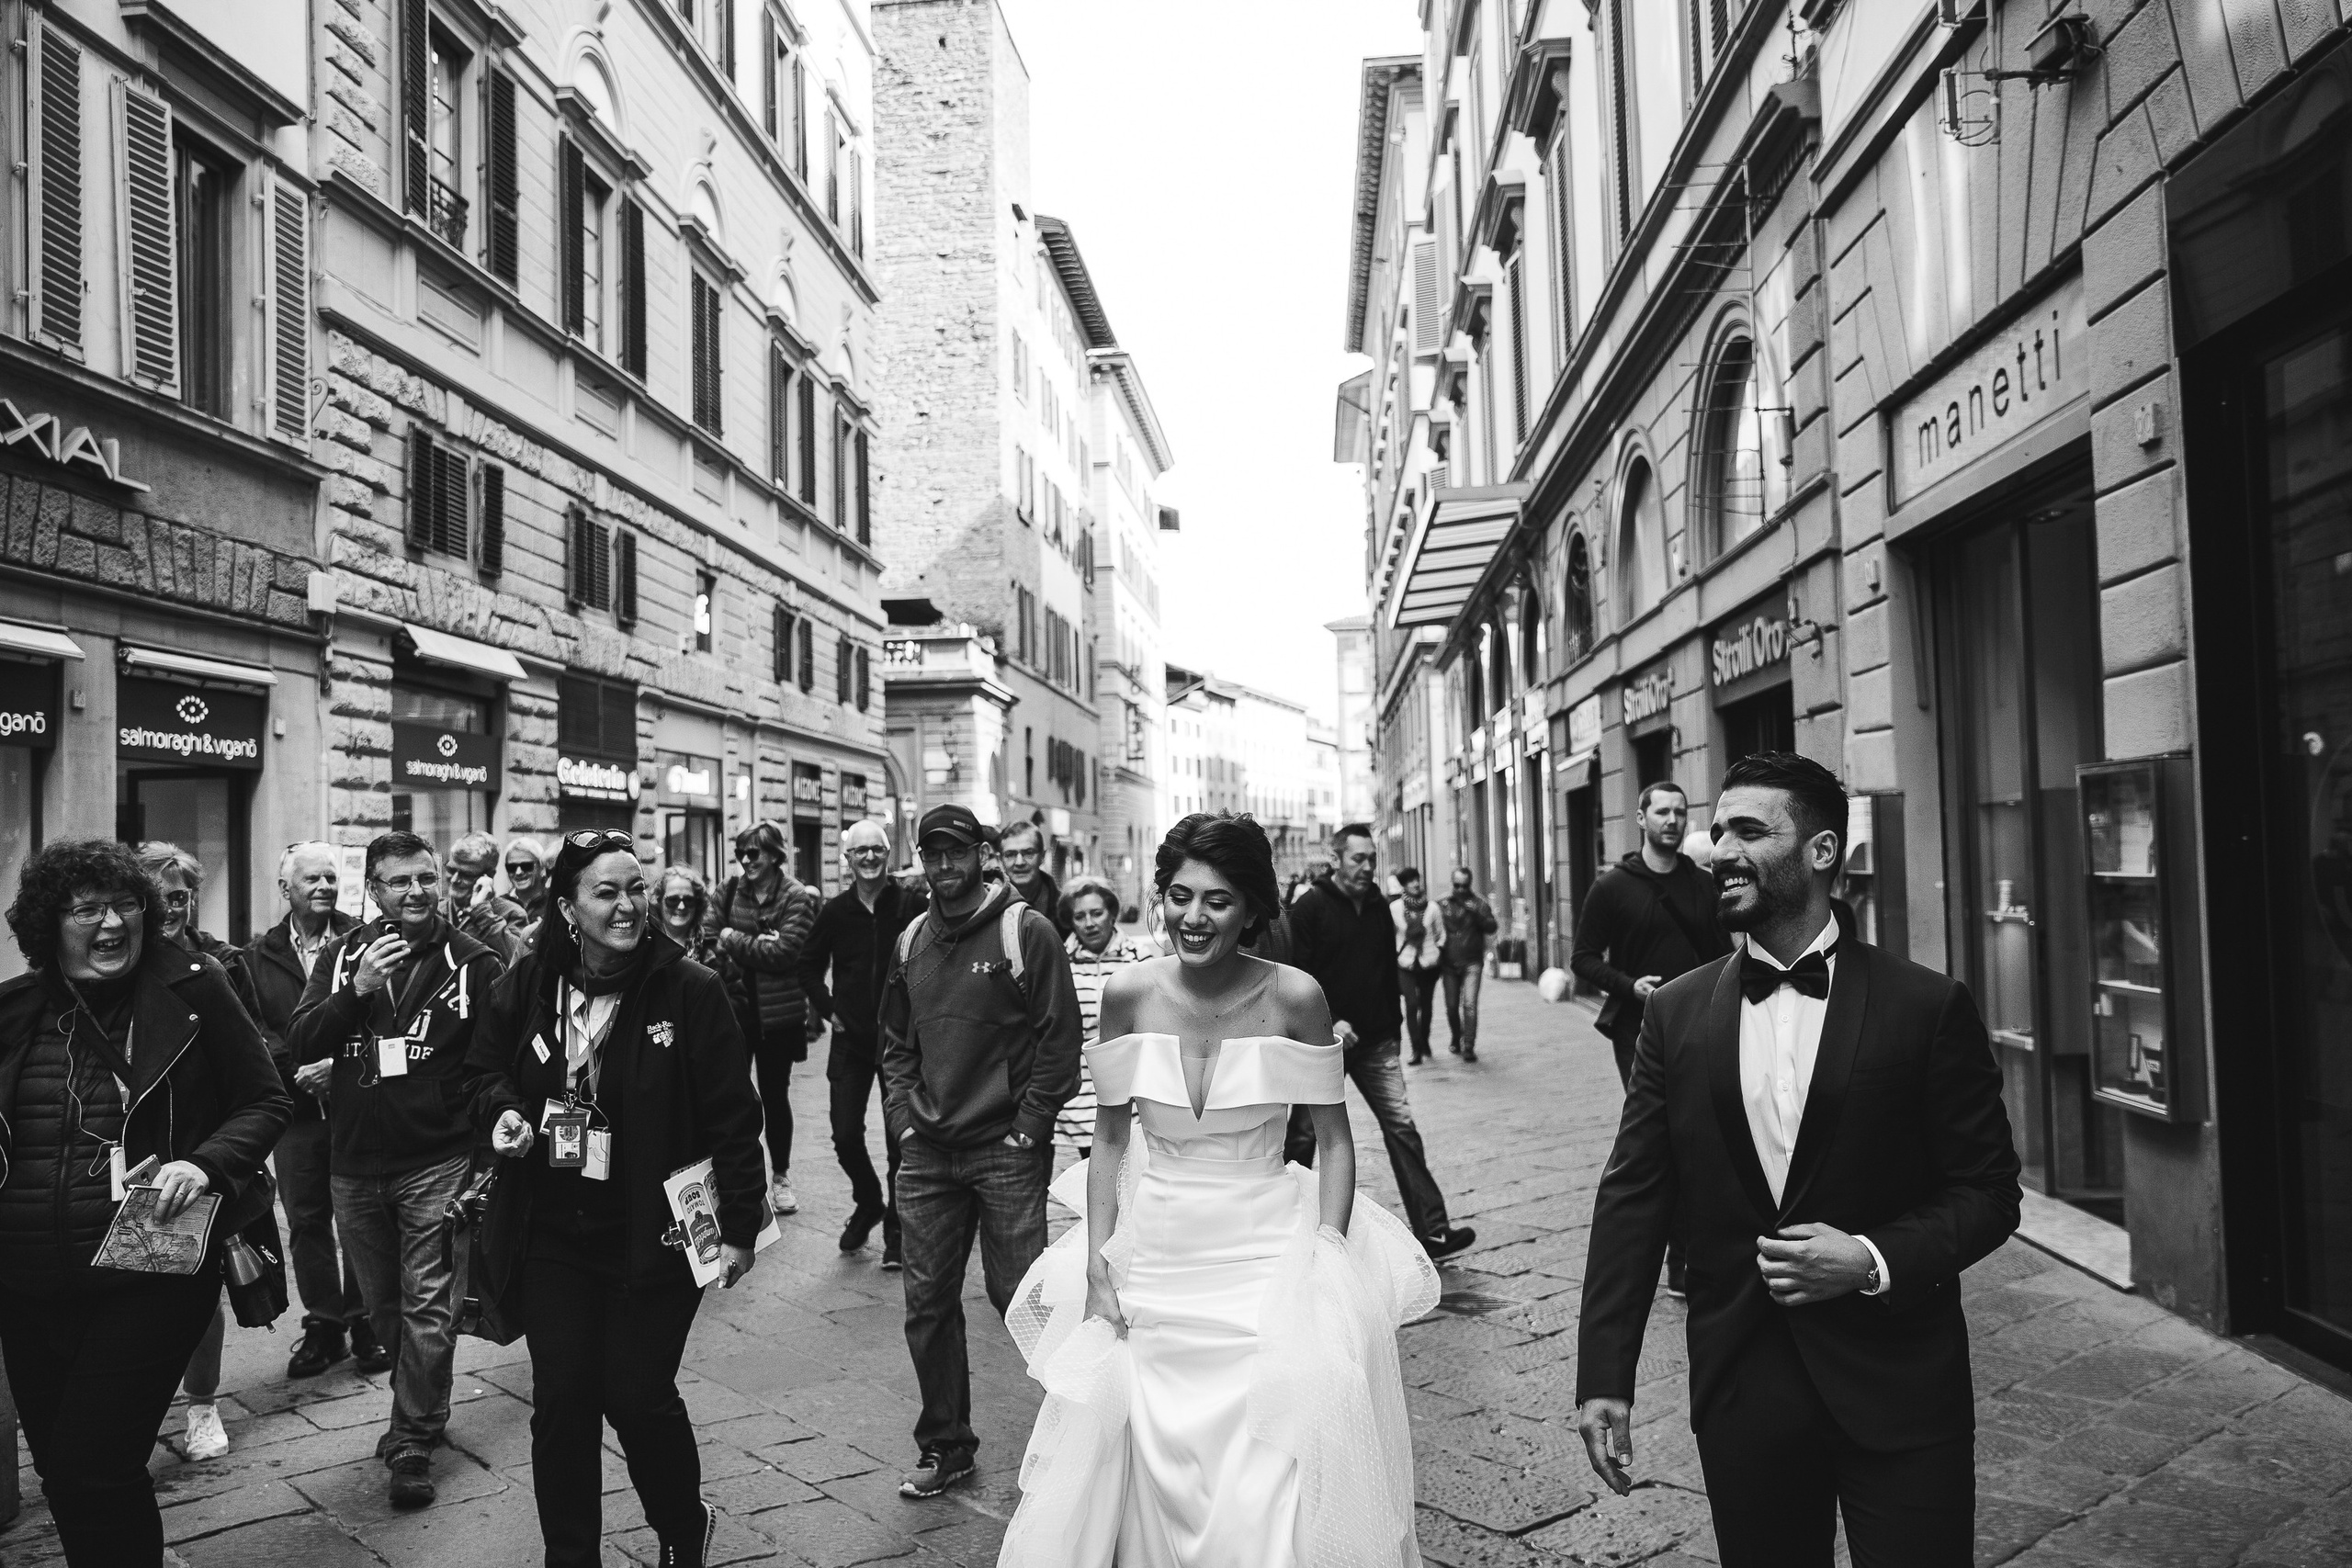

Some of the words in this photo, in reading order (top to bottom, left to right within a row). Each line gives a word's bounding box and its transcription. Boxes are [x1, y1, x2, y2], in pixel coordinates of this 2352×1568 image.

[1917, 310, 2061, 468] manetti
[0, 399, 152, 493] XIAL
[684, 1190, 701, 1205] SOUP
[686, 1199, 706, 1214] TOMATO
